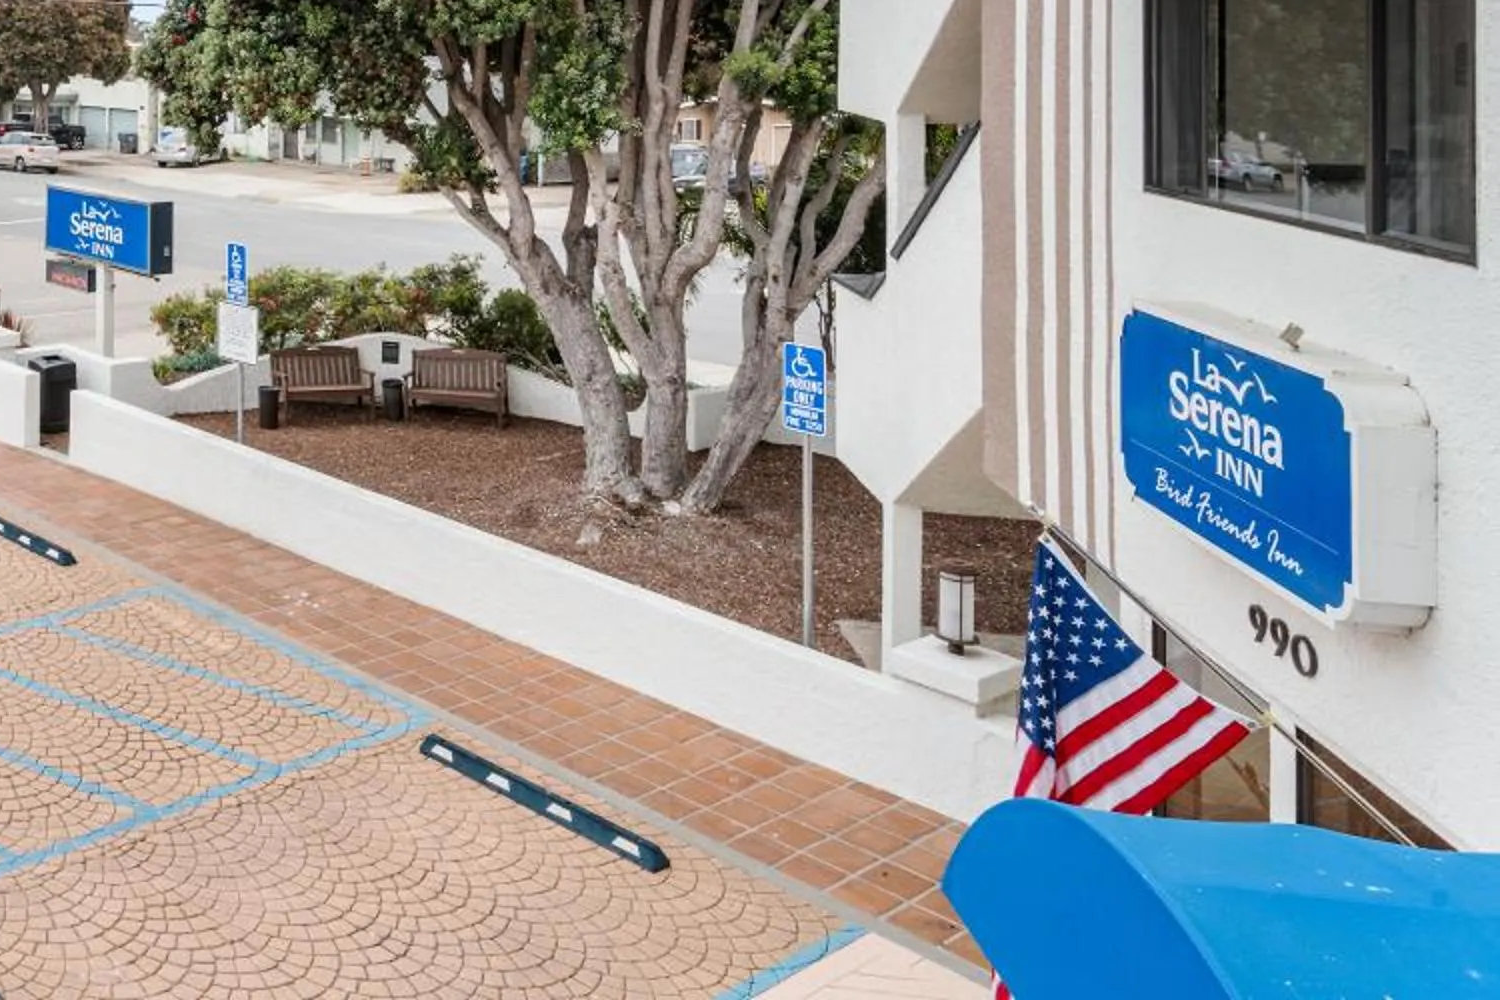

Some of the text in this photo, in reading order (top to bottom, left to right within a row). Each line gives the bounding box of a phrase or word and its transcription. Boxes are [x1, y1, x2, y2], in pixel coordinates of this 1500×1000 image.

[70, 212, 124, 245] Serena
[91, 242, 115, 259] INN
[785, 375, 823, 395] PARKING
[1191, 348, 1220, 393] La
[793, 390, 815, 407] ONLY
[1168, 371, 1285, 470] Serena
[1215, 448, 1263, 497] INN
[1154, 467, 1304, 577] Bird Friends Inn
[1248, 603, 1319, 679] 990
